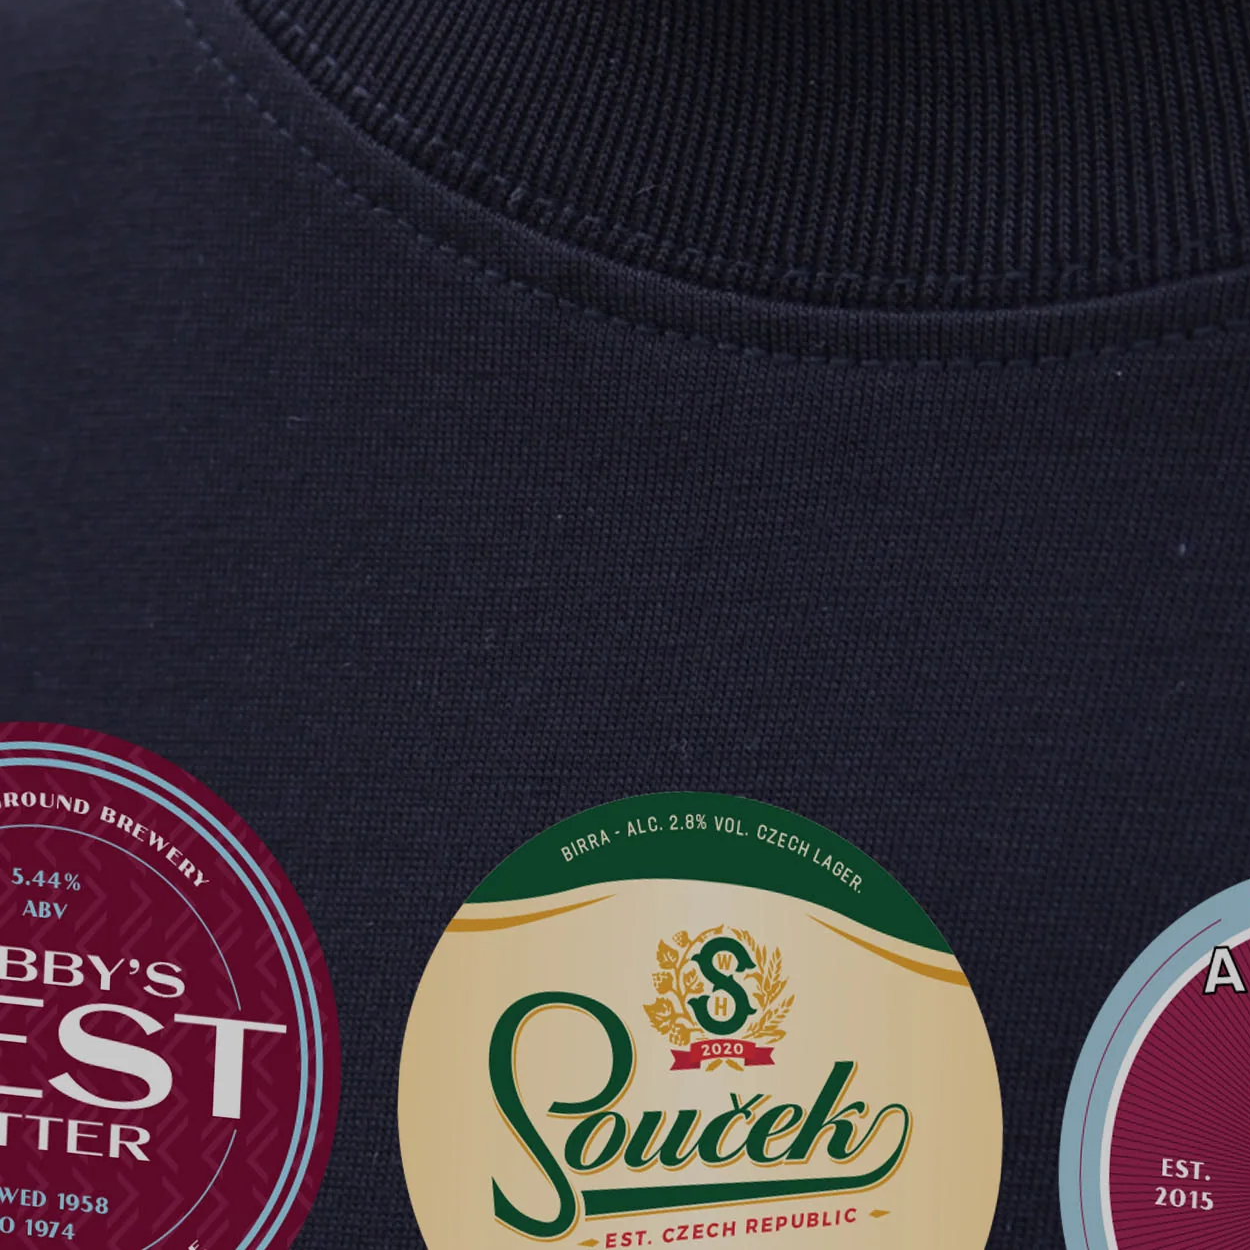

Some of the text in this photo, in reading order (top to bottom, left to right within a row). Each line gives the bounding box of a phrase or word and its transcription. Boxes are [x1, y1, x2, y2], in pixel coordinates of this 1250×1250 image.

[0, 791, 210, 888] ROUND BREWERY
[560, 829, 611, 862] BIRRA
[627, 816, 664, 837] ALC.
[669, 813, 707, 831] 2.8%
[714, 816, 749, 837] VOL.
[757, 824, 810, 858] CZECH
[812, 848, 863, 894] LAGER.
[11, 868, 81, 891] 5.44%
[22, 900, 68, 920] ABV
[701, 1043, 744, 1056] 2020
[488, 990, 914, 1241] Souček
[1161, 1158, 1211, 1181] EST.
[57, 1192, 109, 1215] 1958
[1154, 1186, 1214, 1210] 2015
[25, 1219, 76, 1240] 1974
[605, 1207, 857, 1248] EST. CZECH REPUBLIC
